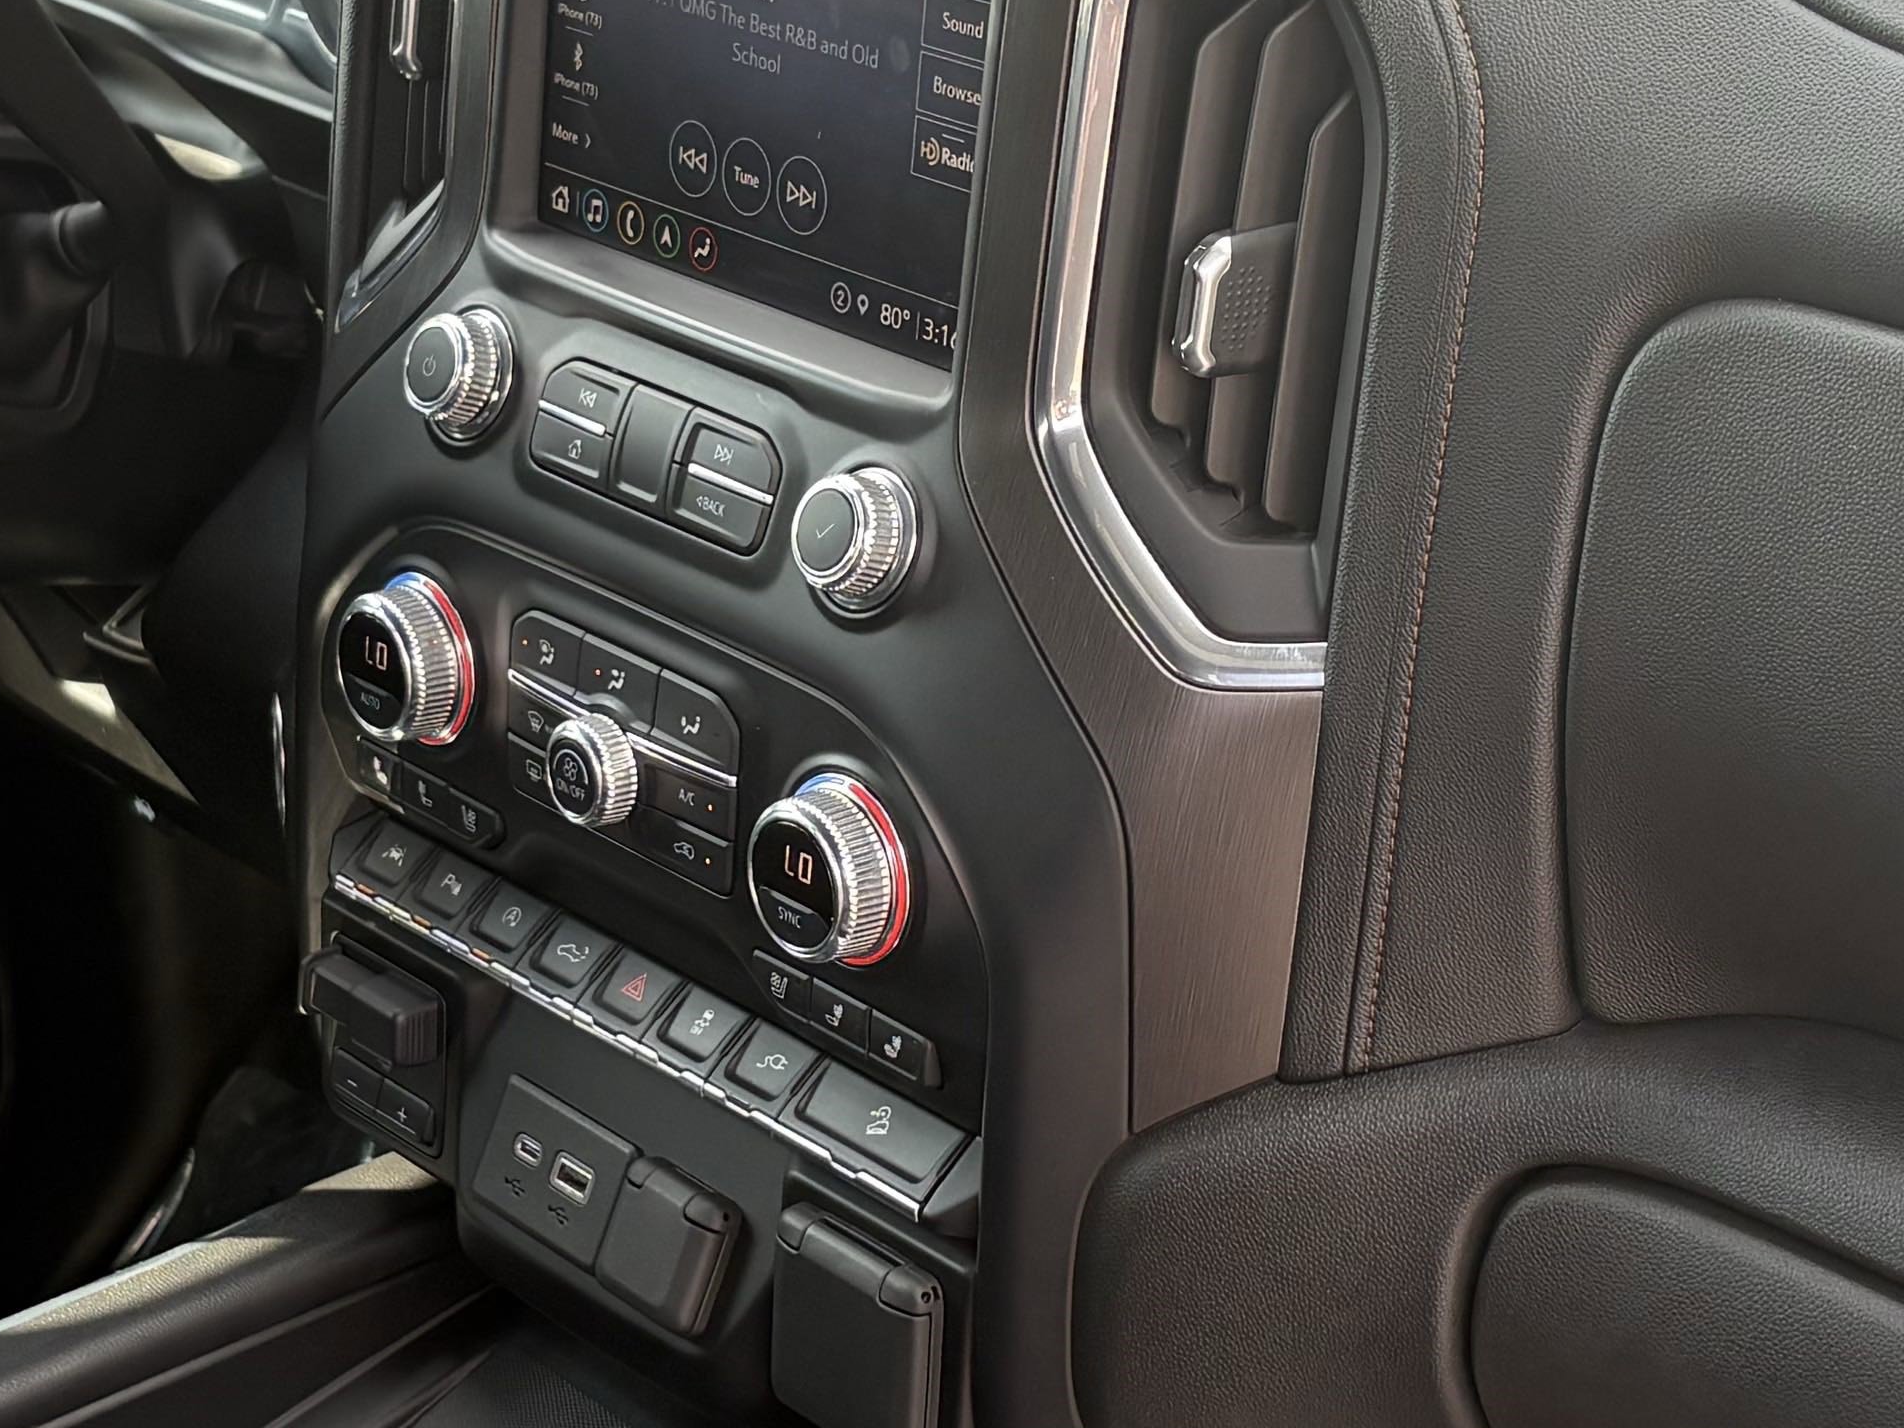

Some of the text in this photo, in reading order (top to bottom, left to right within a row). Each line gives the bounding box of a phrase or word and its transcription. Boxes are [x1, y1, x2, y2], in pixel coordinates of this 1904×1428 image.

[719, 2, 747, 30] The
[749, 13, 782, 42] Best
[785, 23, 818, 51] R&B
[820, 38, 849, 61] and
[852, 42, 880, 69] Old
[942, 11, 985, 40] Sound
[731, 42, 782, 75] School
[932, 74, 983, 107] Browse
[552, 122, 579, 146] More
[733, 165, 760, 189] Tune
[678, 787, 696, 807] A/C
[777, 905, 801, 929] SYNC
